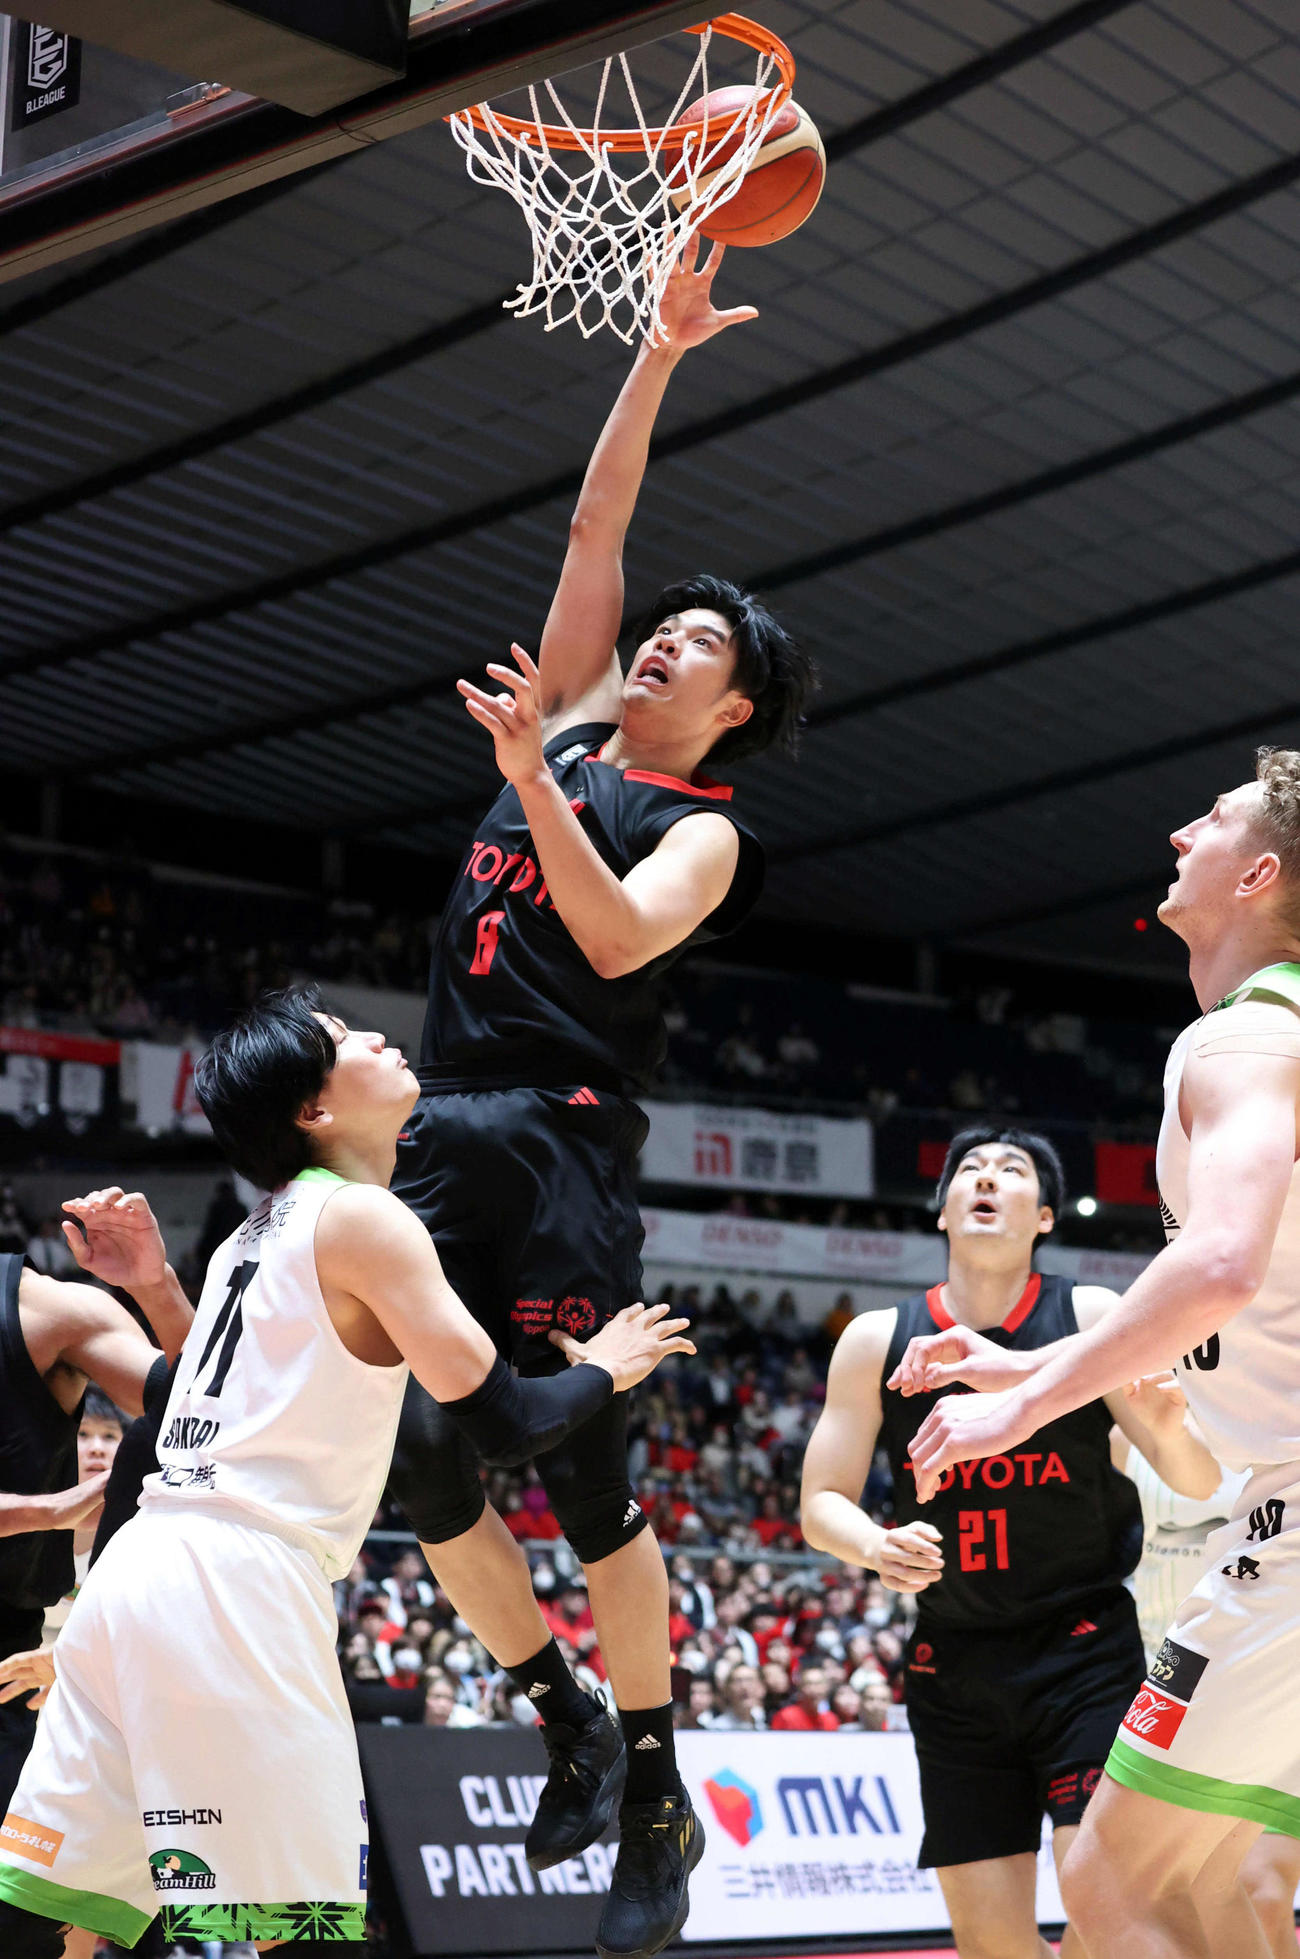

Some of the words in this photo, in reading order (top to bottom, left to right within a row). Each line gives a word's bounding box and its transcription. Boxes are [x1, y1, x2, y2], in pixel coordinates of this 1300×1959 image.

[26, 86, 66, 114] B.LEAGUE
[463, 841, 557, 911] TOYO
[187, 1260, 260, 1398] 11
[904, 1452, 1070, 1491] OYOTA
[958, 1509, 1009, 1572] 21
[635, 1741, 661, 1750] adidas
[143, 1809, 222, 1827] EISHIN
[459, 1775, 549, 1827] CLU
[777, 1776, 902, 1836] MKI
[154, 1875, 216, 1890] eamHill
